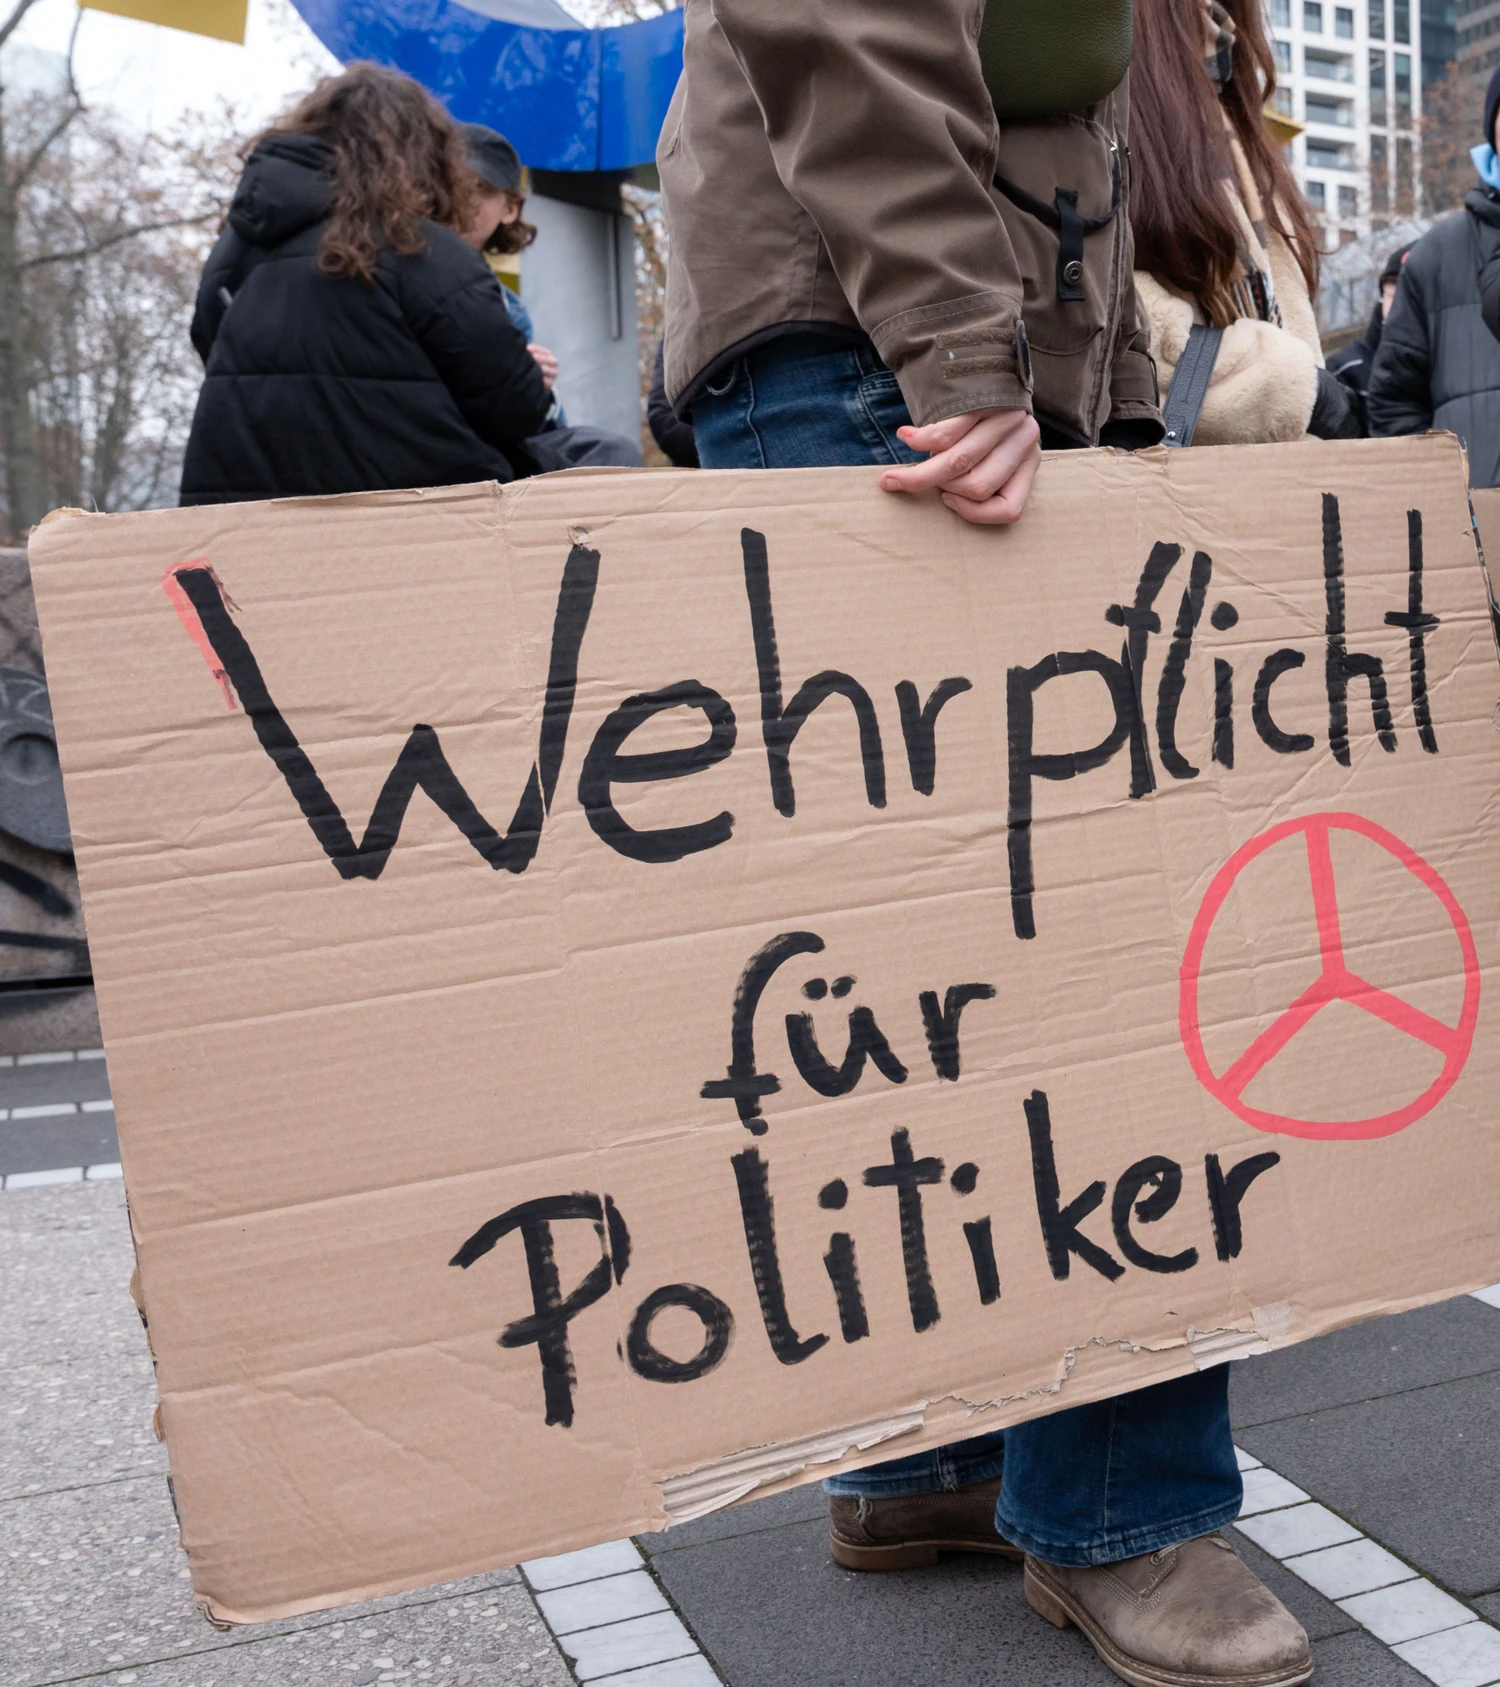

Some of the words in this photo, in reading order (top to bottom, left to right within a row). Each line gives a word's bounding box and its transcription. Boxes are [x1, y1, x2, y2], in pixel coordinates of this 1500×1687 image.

[164, 491, 1441, 941] Wehrpflicht
[701, 931, 996, 1135] für
[448, 1090, 1280, 1428] Politiker
